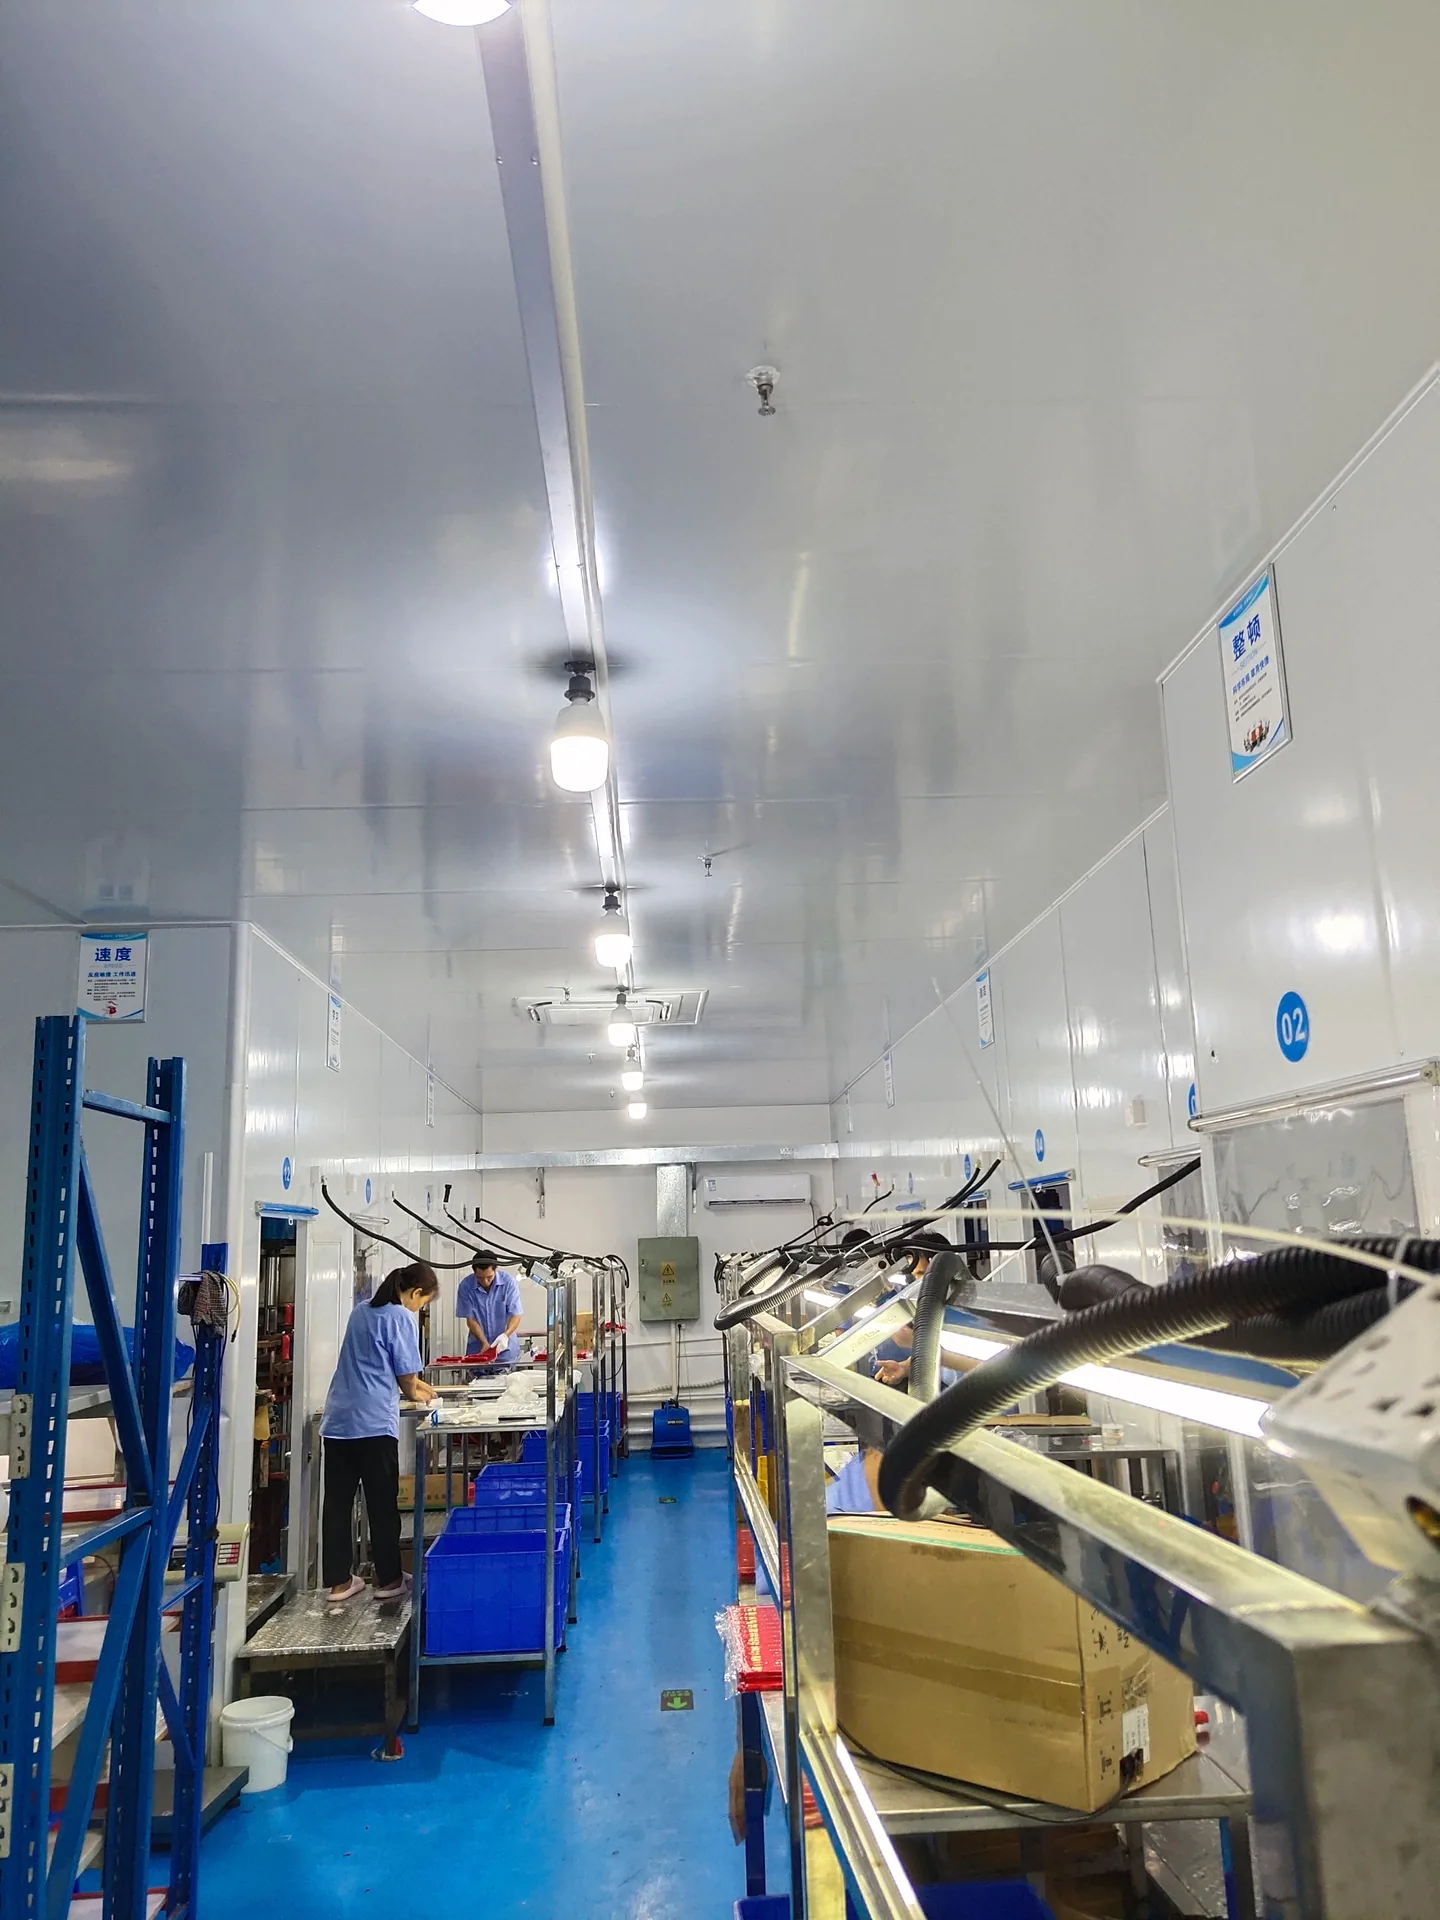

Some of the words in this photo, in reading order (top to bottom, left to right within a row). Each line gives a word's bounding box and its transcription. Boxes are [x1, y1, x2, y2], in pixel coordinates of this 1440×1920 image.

[1232, 613, 1261, 662] 整顿
[95, 947, 131, 961] 速度
[1281, 1007, 1305, 1046] 02
